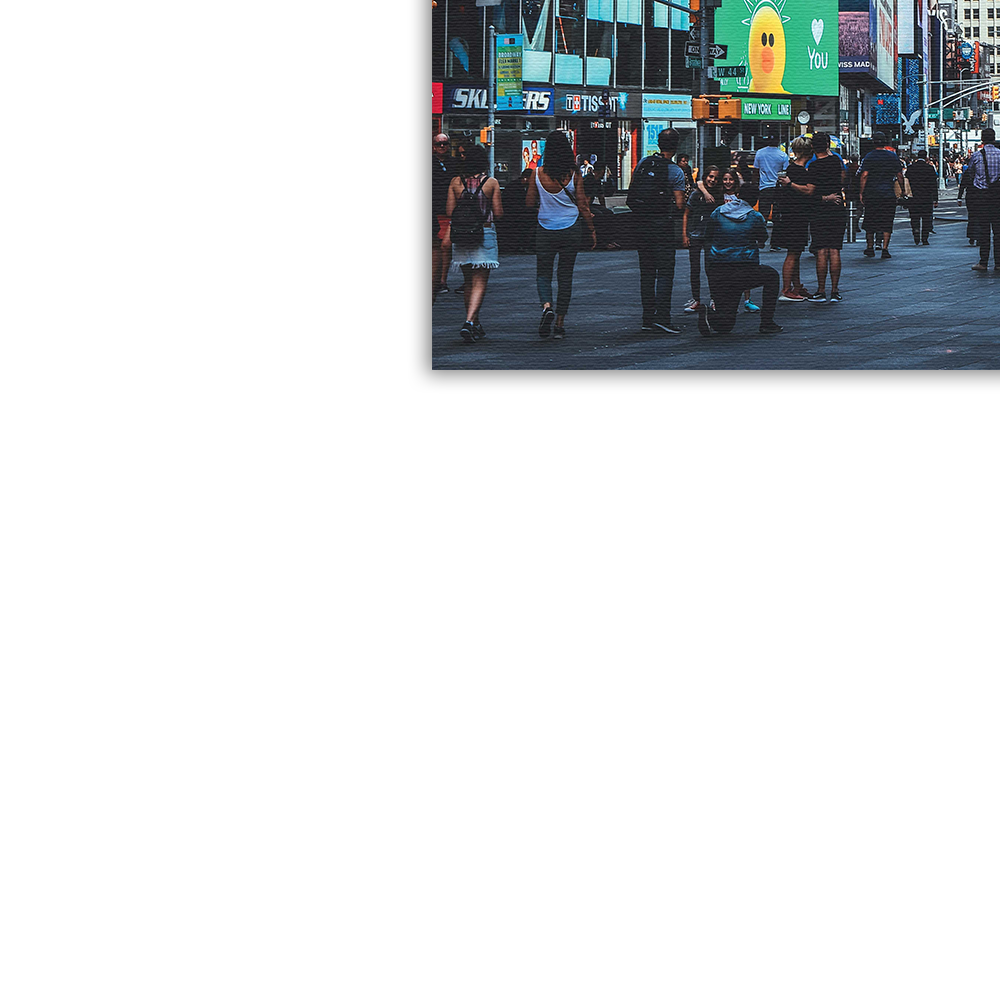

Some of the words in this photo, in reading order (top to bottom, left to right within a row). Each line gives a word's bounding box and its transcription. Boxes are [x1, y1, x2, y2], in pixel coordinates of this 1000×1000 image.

[807, 46, 828, 69] YOU
[718, 67, 725, 77] W
[728, 67, 737, 77] 44
[581, 94, 618, 113] TISST
[744, 103, 757, 115] NEW
[758, 103, 772, 115] YORK
[778, 104, 789, 115] LINE
